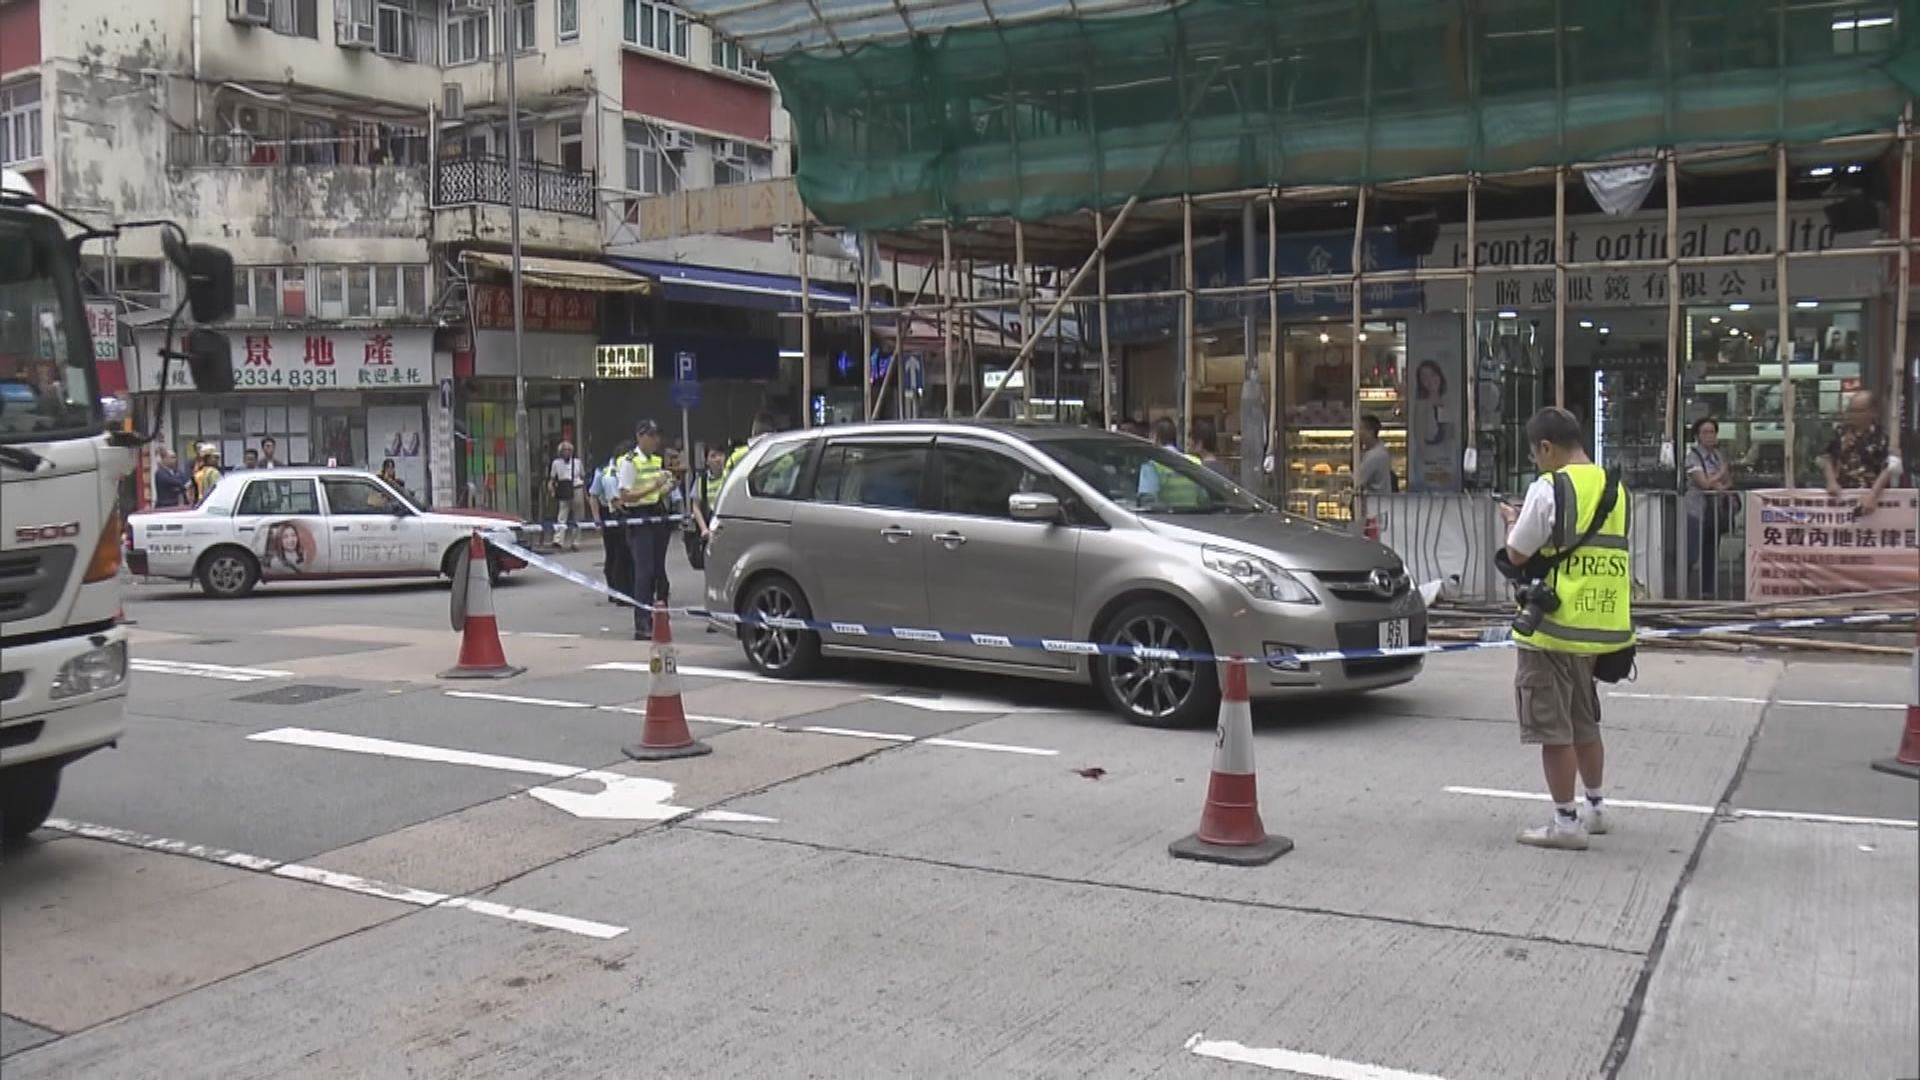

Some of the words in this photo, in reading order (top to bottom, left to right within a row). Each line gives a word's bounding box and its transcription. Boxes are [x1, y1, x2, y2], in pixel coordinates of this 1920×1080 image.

[233, 368, 282, 386] 2334
[289, 369, 337, 386] 8331
[679, 355, 692, 380] P
[16, 522, 79, 543] 500
[1566, 554, 1627, 577] PRESS
[1574, 588, 1617, 614] 記者
